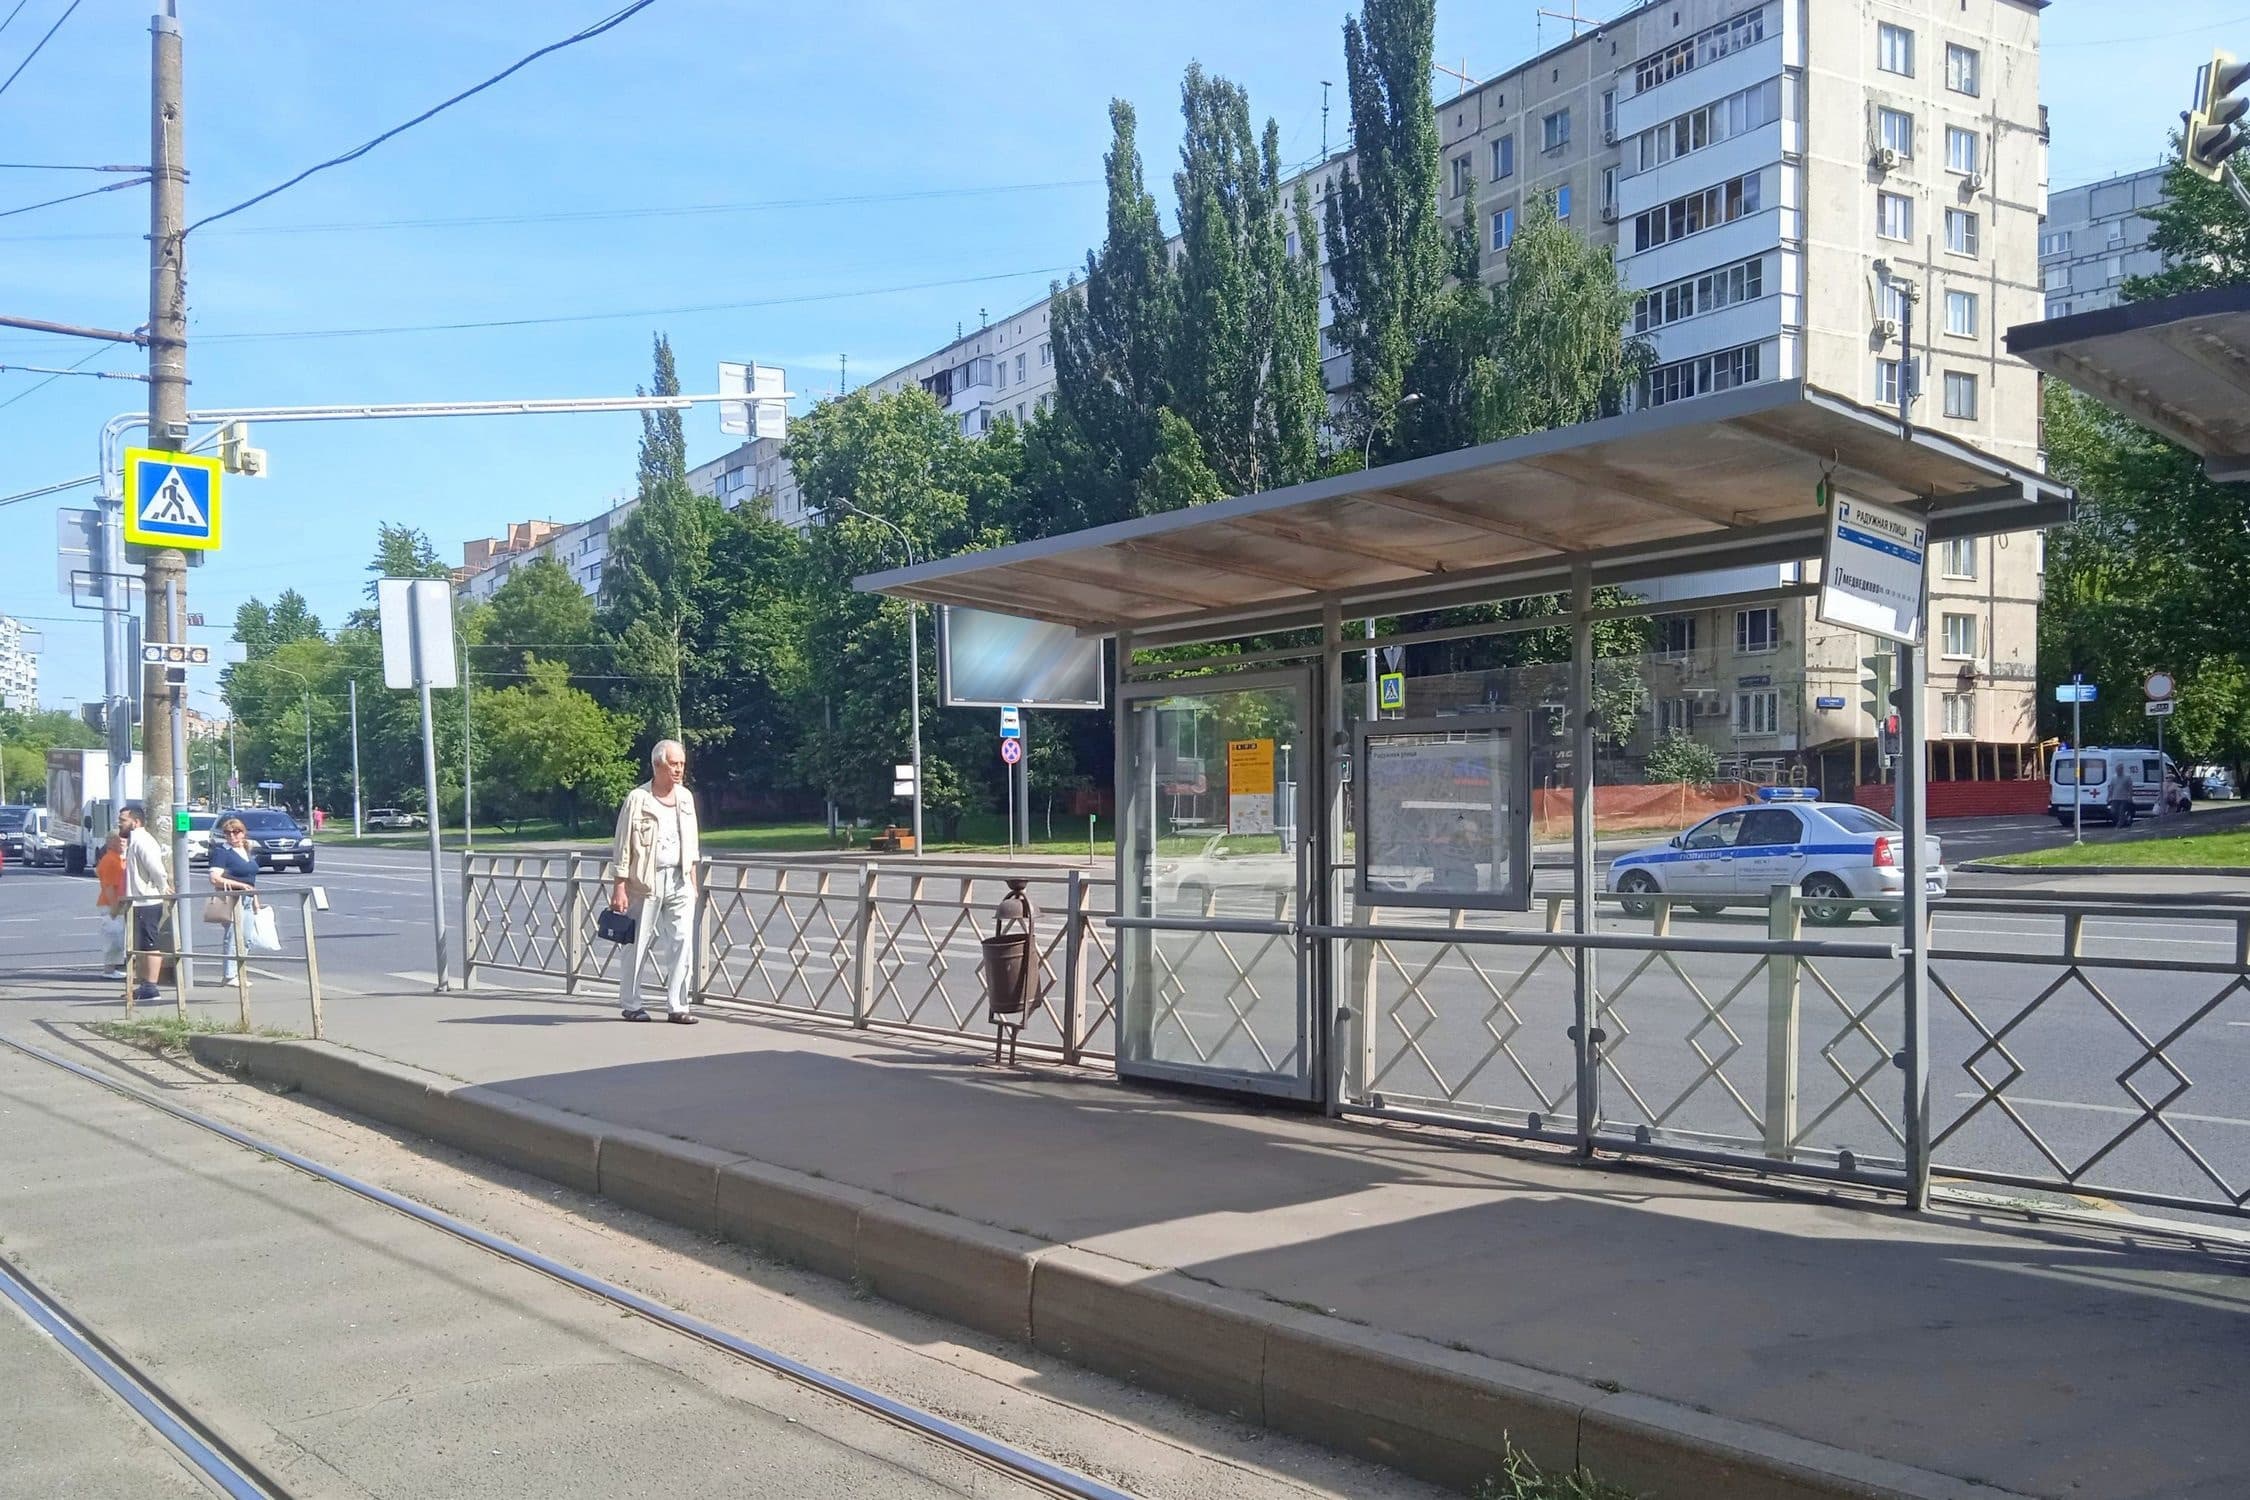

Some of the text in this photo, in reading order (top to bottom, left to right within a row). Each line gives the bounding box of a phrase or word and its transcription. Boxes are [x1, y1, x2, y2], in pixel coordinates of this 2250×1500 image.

[1856, 510, 1908, 538] РАДУЖНАЯ УЛИЦА
[1834, 566, 1880, 594] 17 МЕДВЕДКОВО
